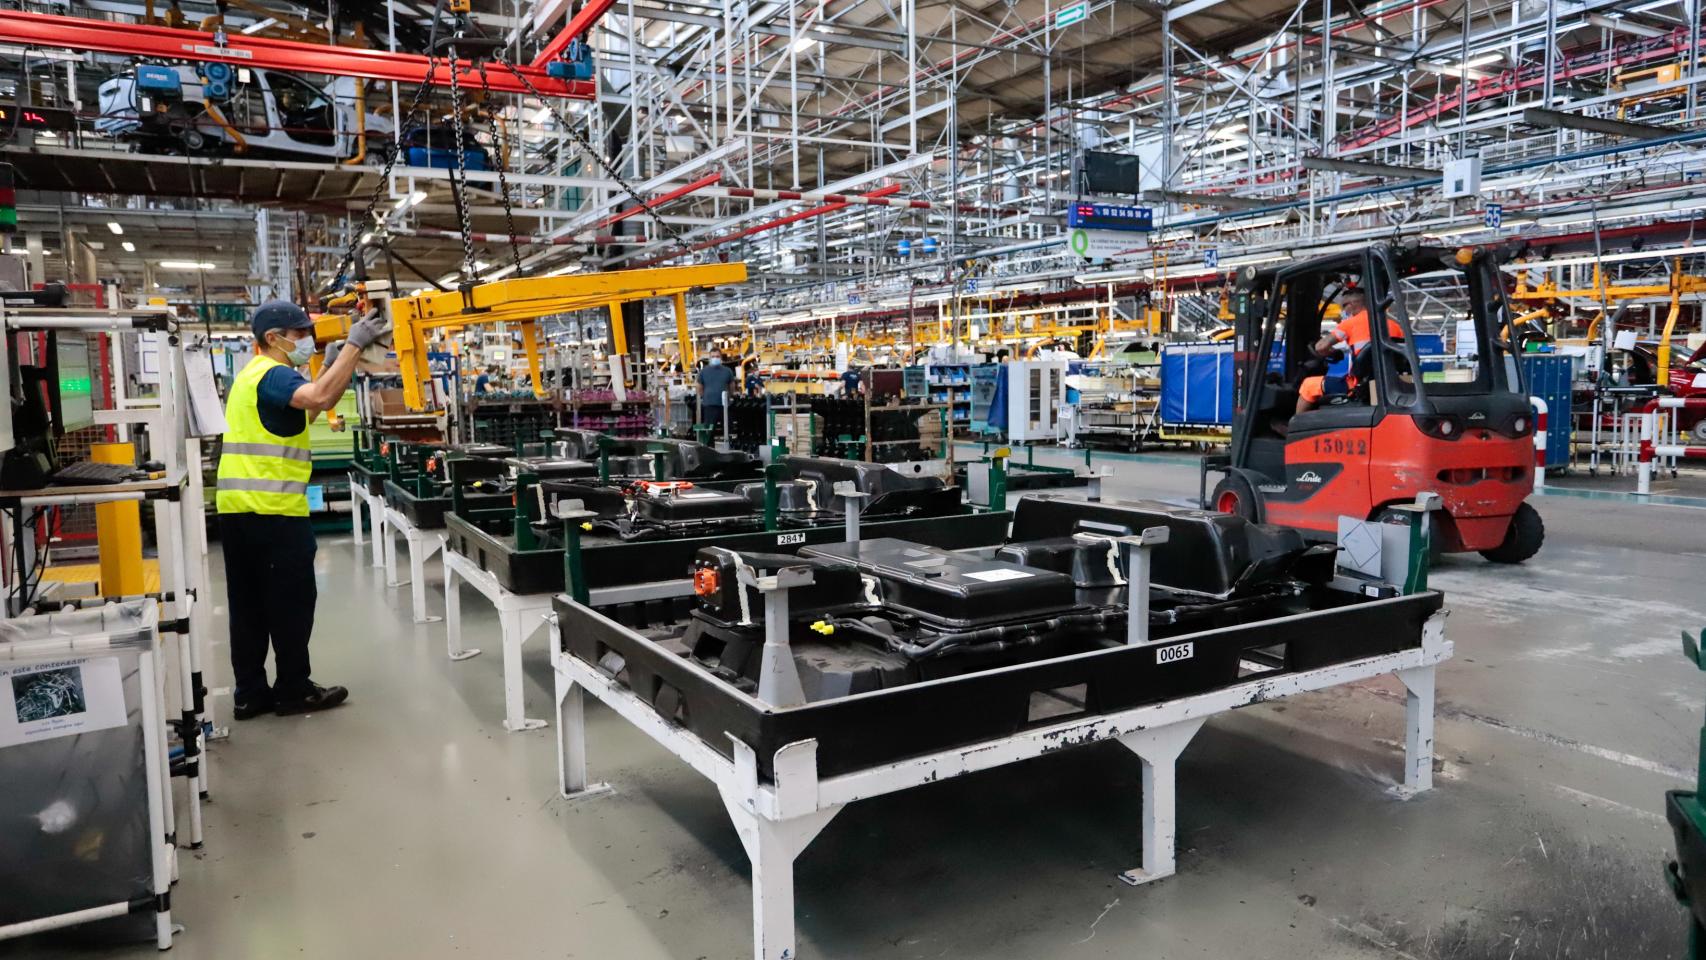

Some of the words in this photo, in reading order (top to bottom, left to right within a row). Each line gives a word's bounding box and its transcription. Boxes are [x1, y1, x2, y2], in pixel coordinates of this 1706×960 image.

[1486, 205, 1500, 227] 55
[1204, 250, 1217, 268] 54
[966, 280, 977, 292] 53
[1313, 438, 1366, 455] 13022
[1296, 471, 1322, 483] Linde
[1160, 644, 1190, 662] 0065
